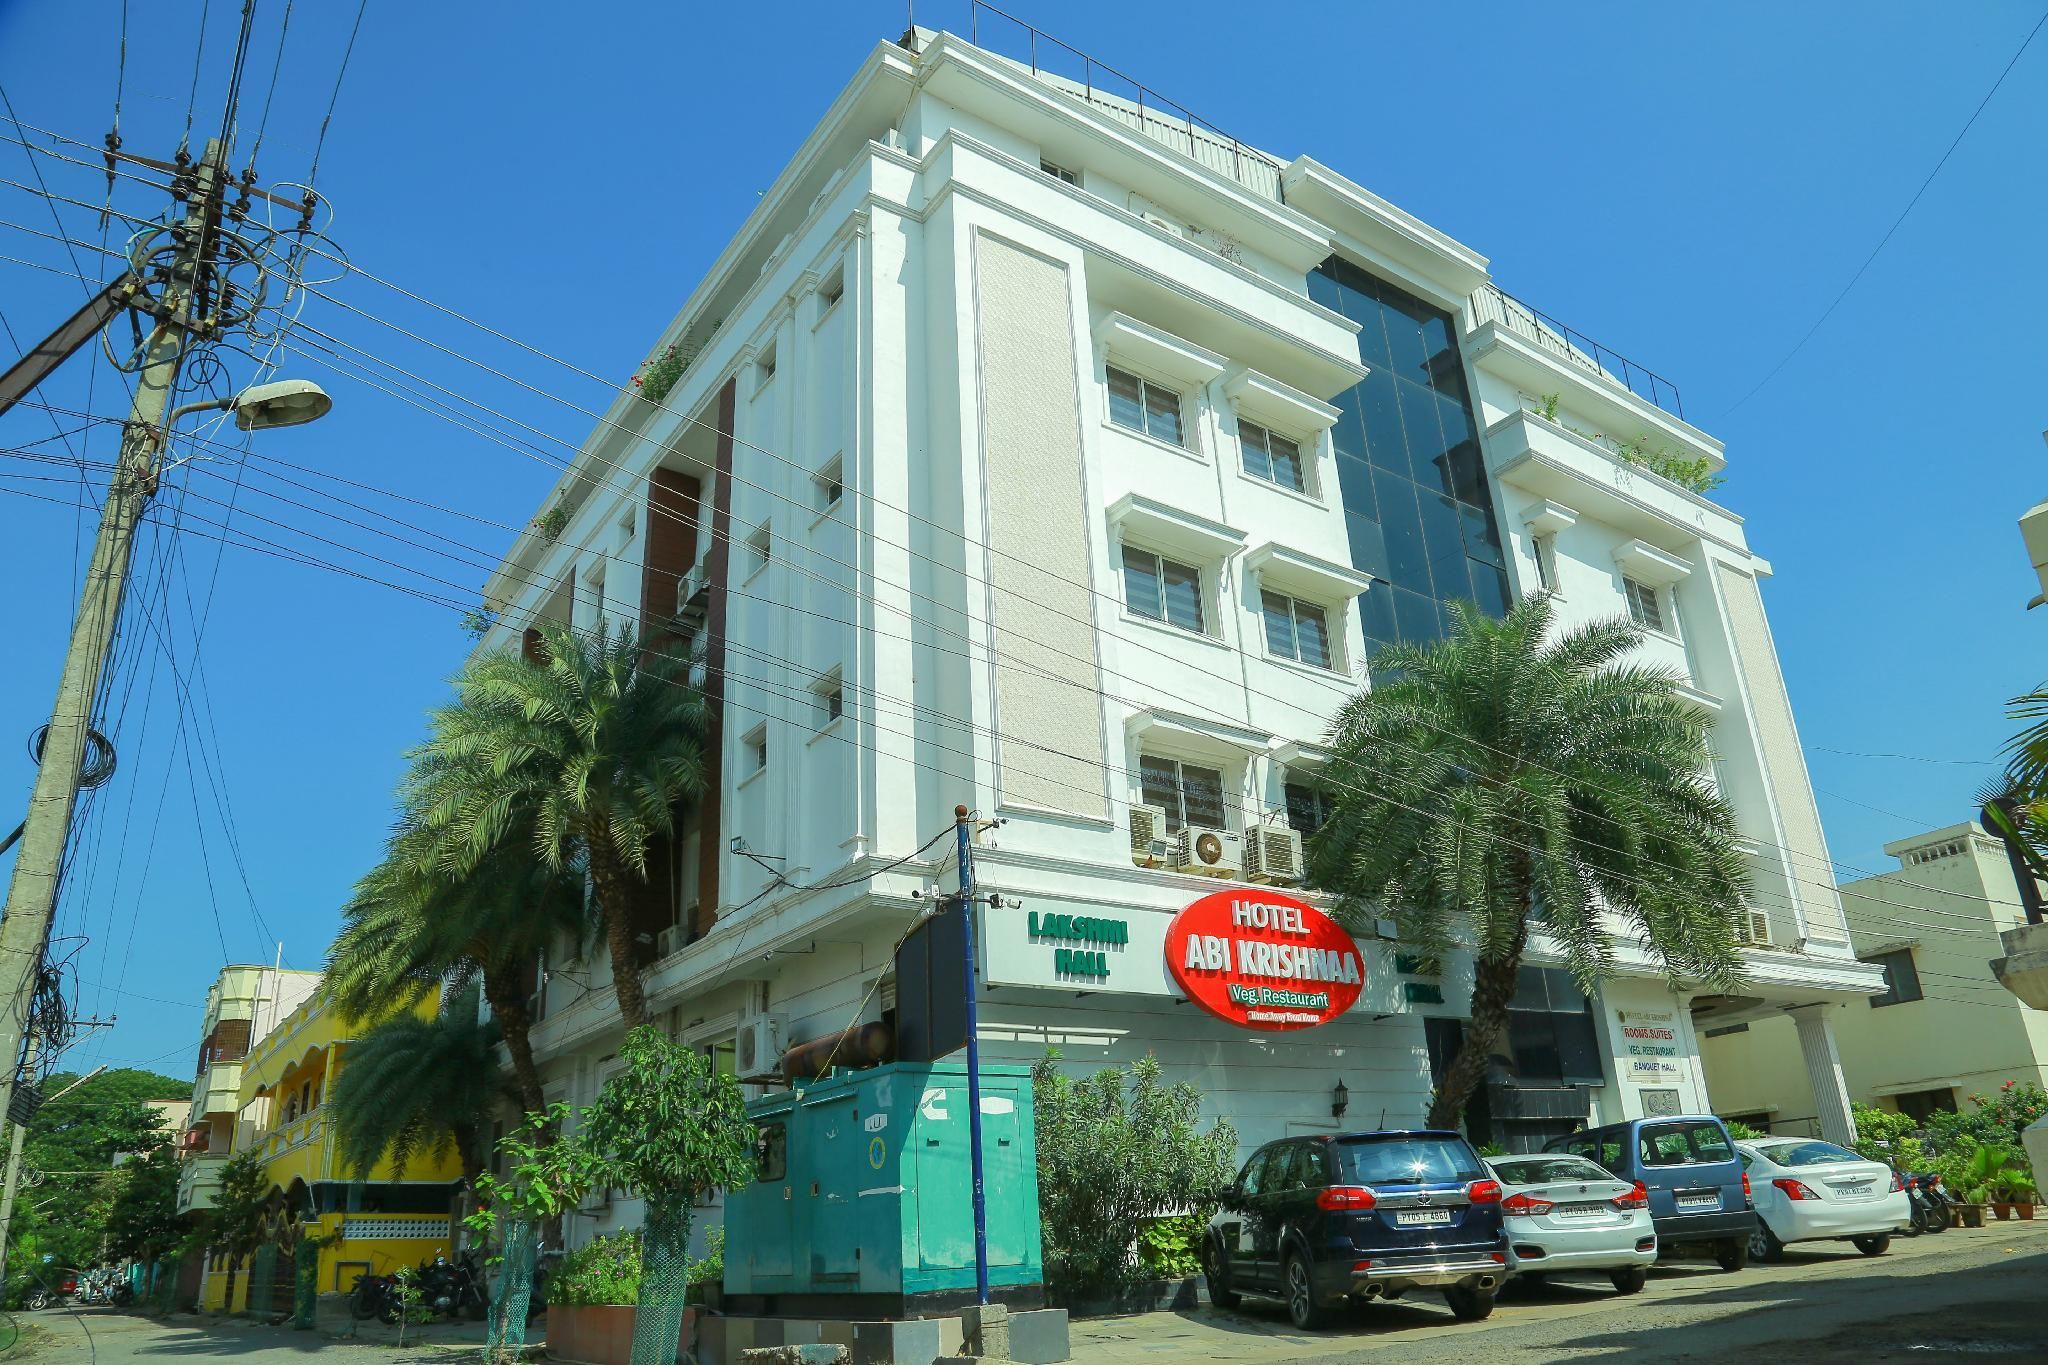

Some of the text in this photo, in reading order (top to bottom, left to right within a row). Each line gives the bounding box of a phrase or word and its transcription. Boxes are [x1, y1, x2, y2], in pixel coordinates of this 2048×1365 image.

[1028, 911, 1128, 944] LAKSHMI
[1232, 900, 1310, 934] HOTEL
[1055, 949, 1110, 976] HALL
[1184, 934, 1232, 972] ABI
[1236, 940, 1361, 985] KRISHNAA
[1232, 985, 1328, 1007] Veg. Restaurant
[1643, 1046, 1676, 1056] RESTAURANT
[1634, 1062, 1676, 1072] BANQUET HALL
